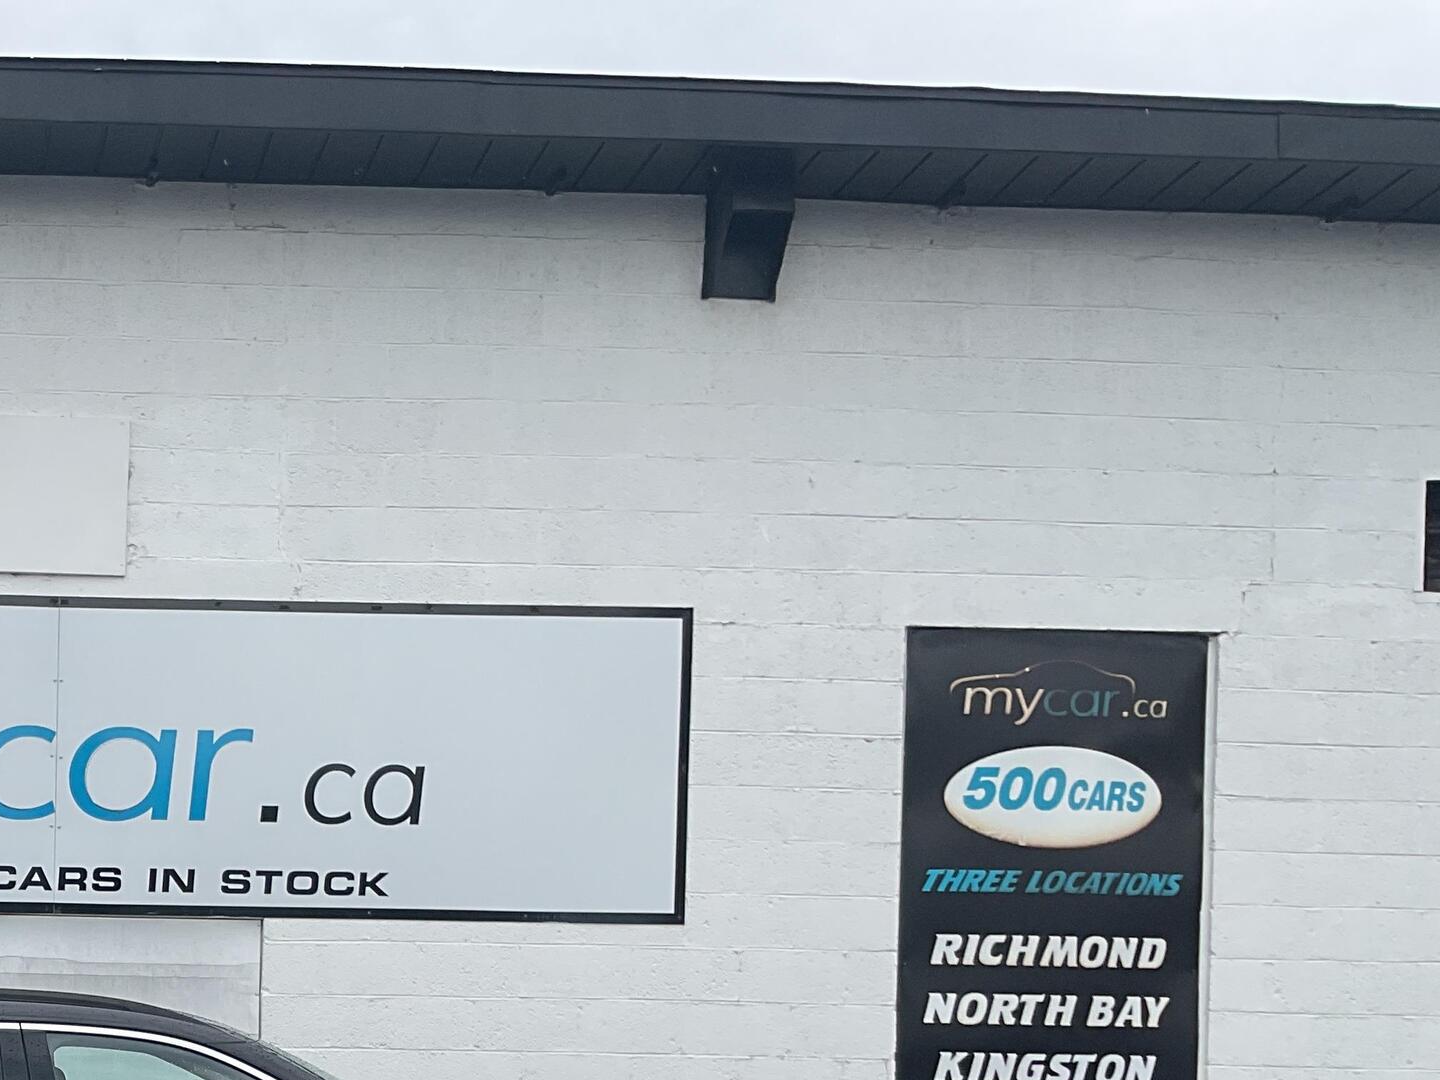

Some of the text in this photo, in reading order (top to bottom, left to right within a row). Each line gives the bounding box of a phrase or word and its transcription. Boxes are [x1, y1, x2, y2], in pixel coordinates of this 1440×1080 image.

[962, 767, 1146, 813] 500 CARS
[149, 868, 195, 893] IN
[220, 869, 389, 897] STOCK
[922, 869, 1183, 896] THREE LOCATIONS
[930, 933, 1167, 969] RICHMOND
[923, 992, 1170, 1028] NORTH BAY
